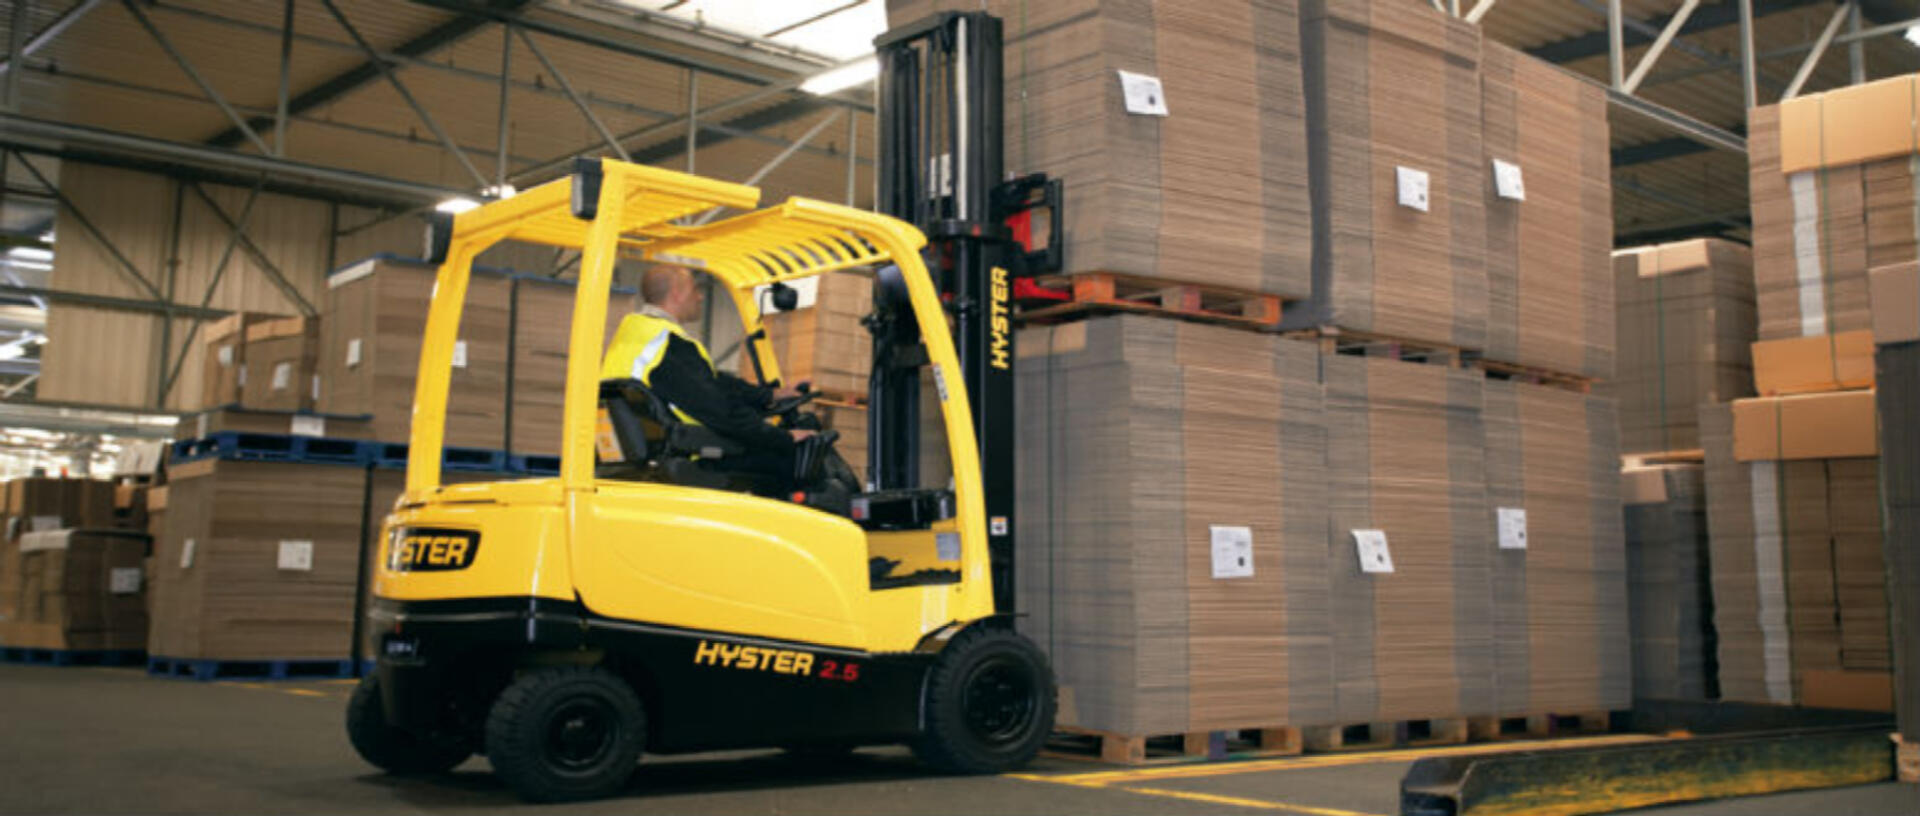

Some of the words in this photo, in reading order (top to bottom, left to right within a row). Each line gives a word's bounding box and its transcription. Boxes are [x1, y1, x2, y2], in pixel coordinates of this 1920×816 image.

[989, 266, 1009, 370] HYSTER
[390, 535, 470, 566] STER
[694, 640, 814, 676] HYSTER
[819, 660, 859, 682] 2.5
